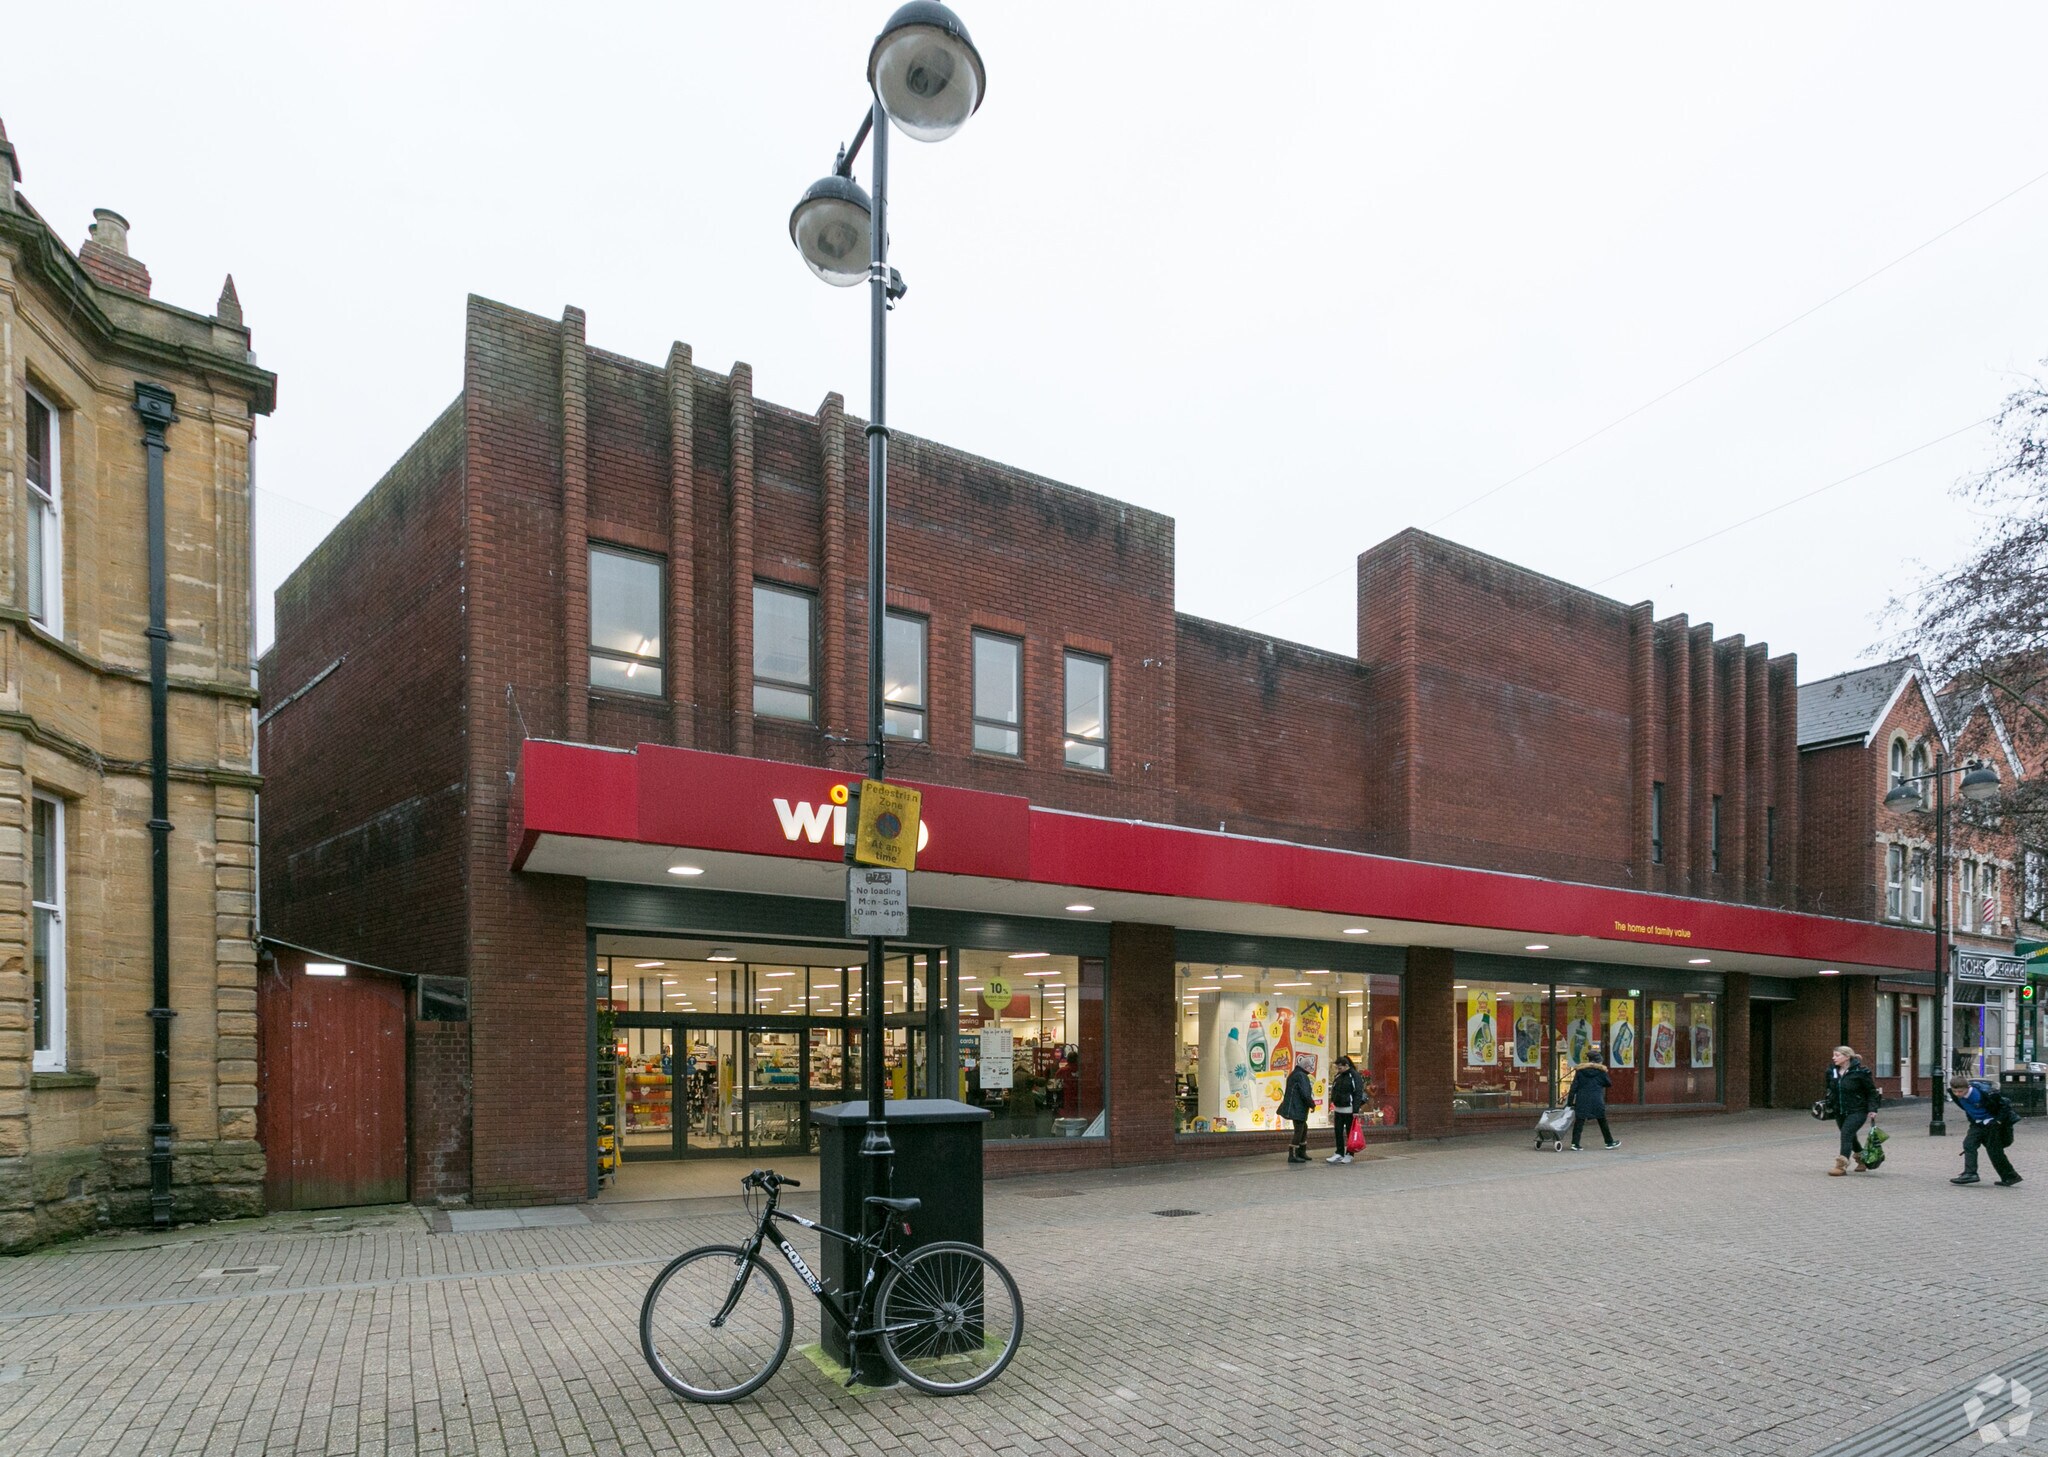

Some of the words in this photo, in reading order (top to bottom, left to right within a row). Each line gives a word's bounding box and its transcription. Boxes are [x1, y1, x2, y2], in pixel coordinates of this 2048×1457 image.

[879, 796, 903, 810] Zone
[871, 840, 882, 850] At
[886, 844, 902, 854] any
[876, 852, 897, 863] time
[856, 887, 868, 895] No
[870, 887, 901, 897] loading
[883, 898, 900, 906] Sun
[853, 908, 864, 916] 10
[1615, 921, 1626, 931] The
[1627, 923, 1646, 933] home
[1646, 925, 1654, 934] of
[1654, 925, 1673, 938] family
[1674, 928, 1691, 938] value
